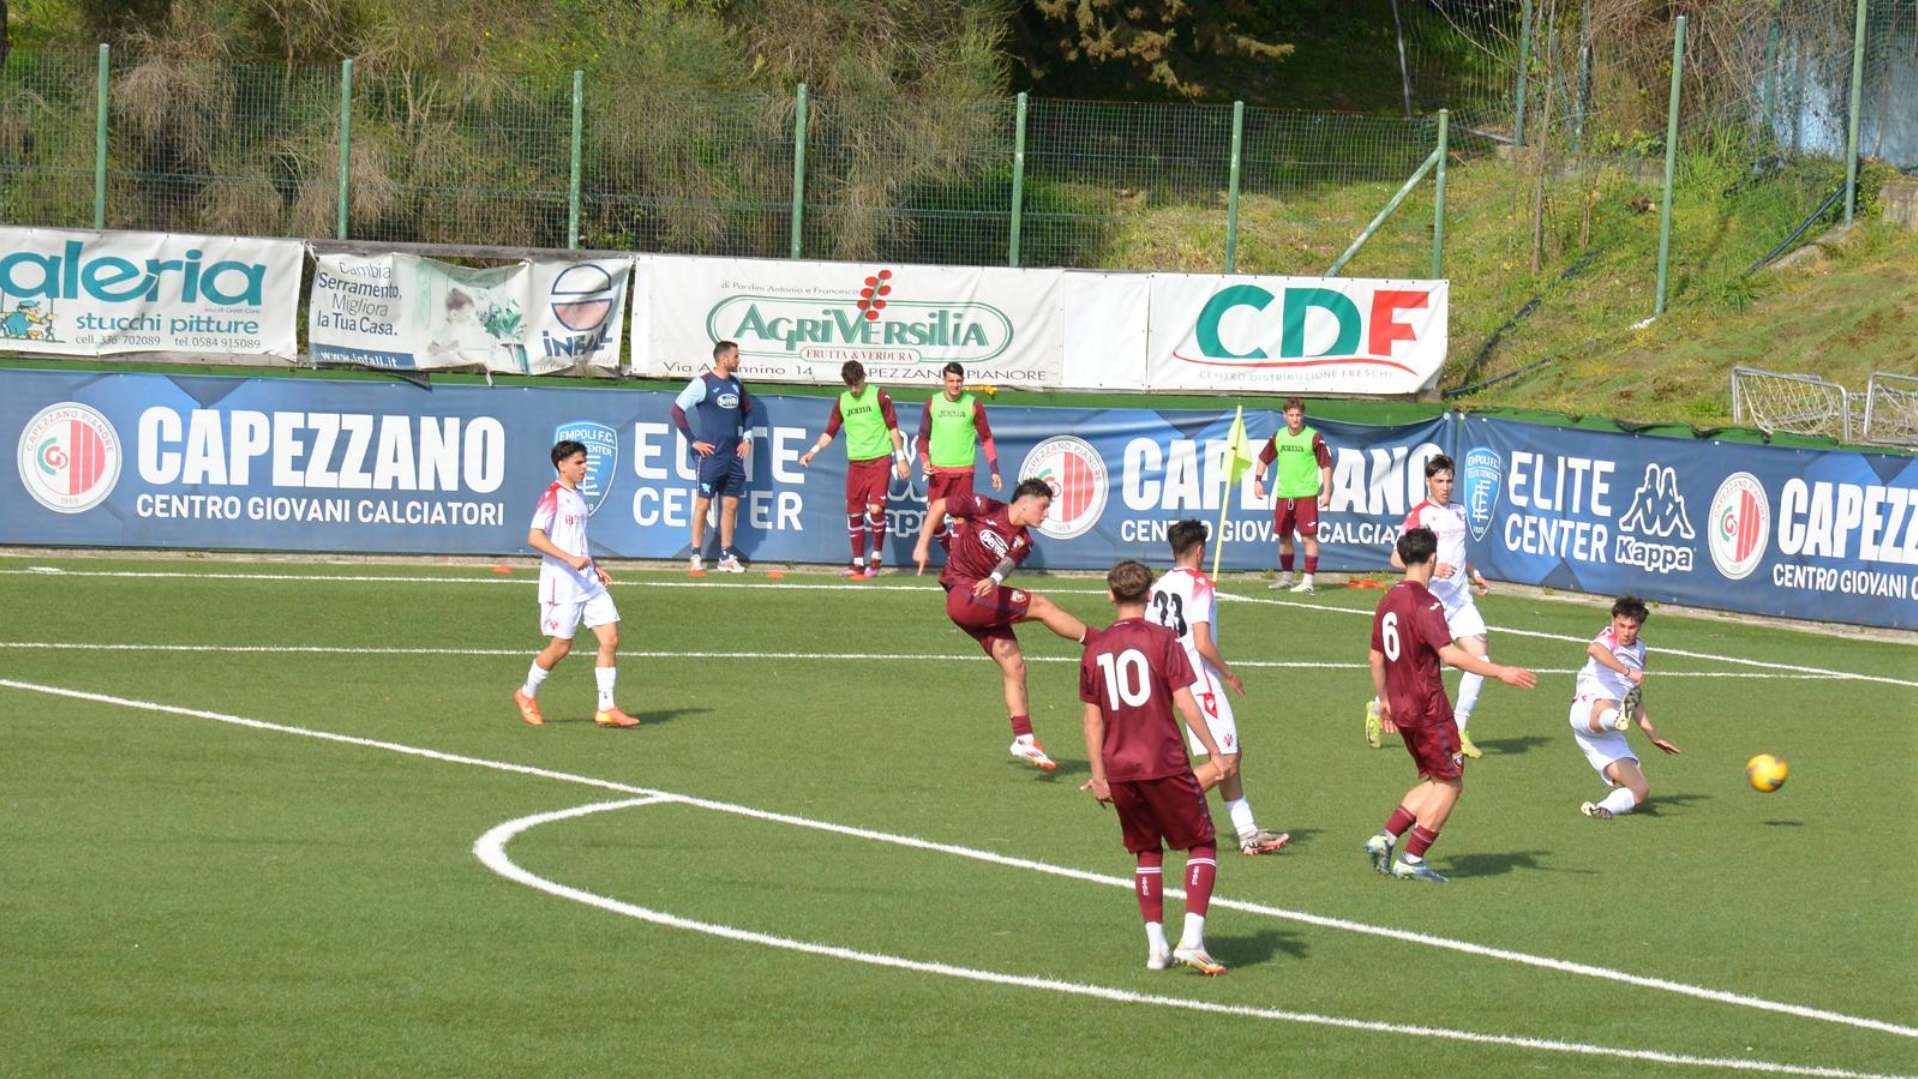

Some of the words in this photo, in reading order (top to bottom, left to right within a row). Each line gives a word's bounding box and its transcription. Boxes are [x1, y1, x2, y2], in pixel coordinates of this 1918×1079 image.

[339, 261, 391, 280] Cambia
[318, 271, 402, 300] Serramento,
[331, 292, 390, 318] Migliora
[76, 312, 161, 332] stucchi
[169, 314, 259, 335] pitture
[317, 309, 329, 328] la
[332, 311, 357, 332] Tua
[359, 316, 398, 336] Casa.
[1195, 284, 1430, 360] CDF
[191, 337, 218, 348] 0584
[220, 338, 262, 350] 915089
[806, 349, 848, 360] FRUTTA
[851, 351, 858, 360] &
[663, 361, 692, 372] Via
[698, 361, 786, 375] Annino
[796, 365, 813, 376] 14
[966, 368, 1047, 381] PIANORE
[137, 405, 505, 494] CAPEZZANO
[559, 429, 597, 441] EMPOLI
[1508, 450, 1616, 518] ELITE
[135, 493, 242, 520] CENTRO
[247, 496, 350, 523] GIOVANI
[357, 500, 505, 526] CALCIATORI
[1504, 512, 1609, 564] CENTER
[1615, 534, 1694, 574] Kappa
[1773, 563, 1838, 592] CENTRO
[1840, 569, 1908, 600] GIOVANI
[1382, 611, 1400, 663] 6
[1097, 648, 1151, 712] 10
